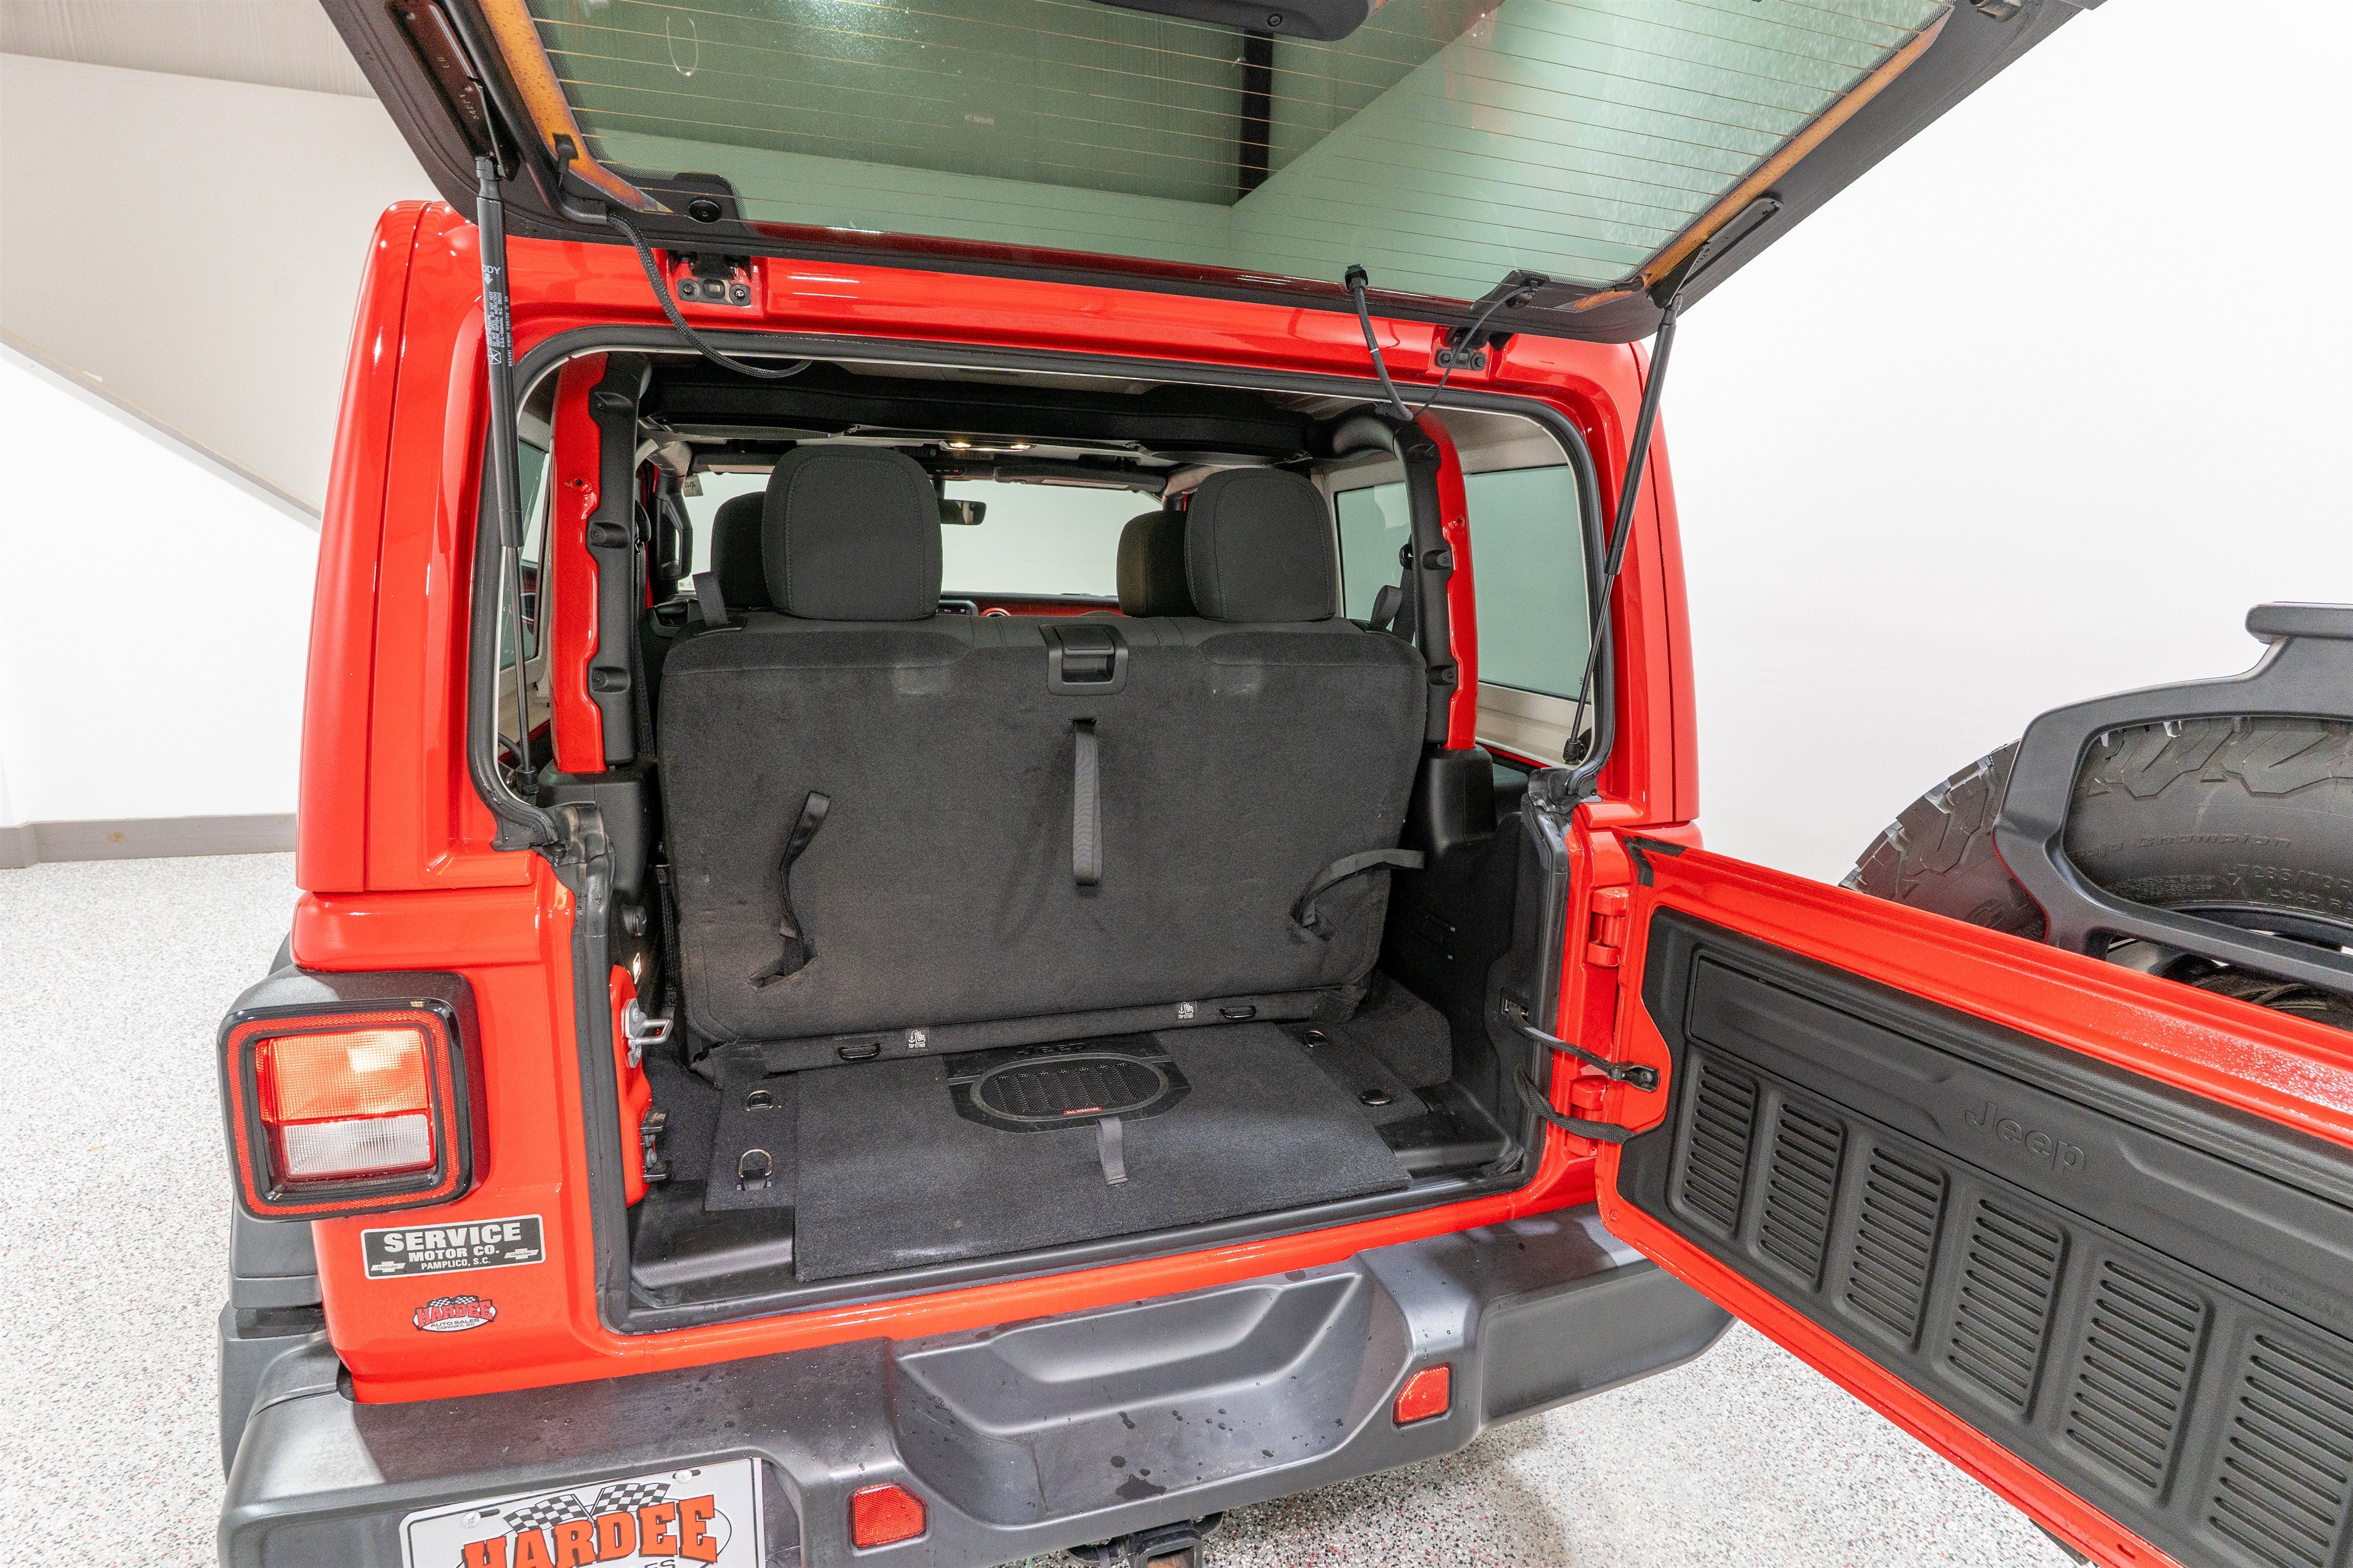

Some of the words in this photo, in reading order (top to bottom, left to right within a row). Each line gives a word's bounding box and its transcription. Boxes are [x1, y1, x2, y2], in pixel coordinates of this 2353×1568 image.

[1017, 1042, 1085, 1055] Jeep
[1965, 1101, 2087, 1175] Jeep
[384, 1222, 522, 1253] SERVICE
[408, 1248, 468, 1262] MOTOR
[473, 1244, 500, 1256] CO.
[421, 1258, 470, 1270] PAMPLICO,
[473, 1257, 491, 1265] S.C.
[416, 1300, 493, 1328] HARDEE
